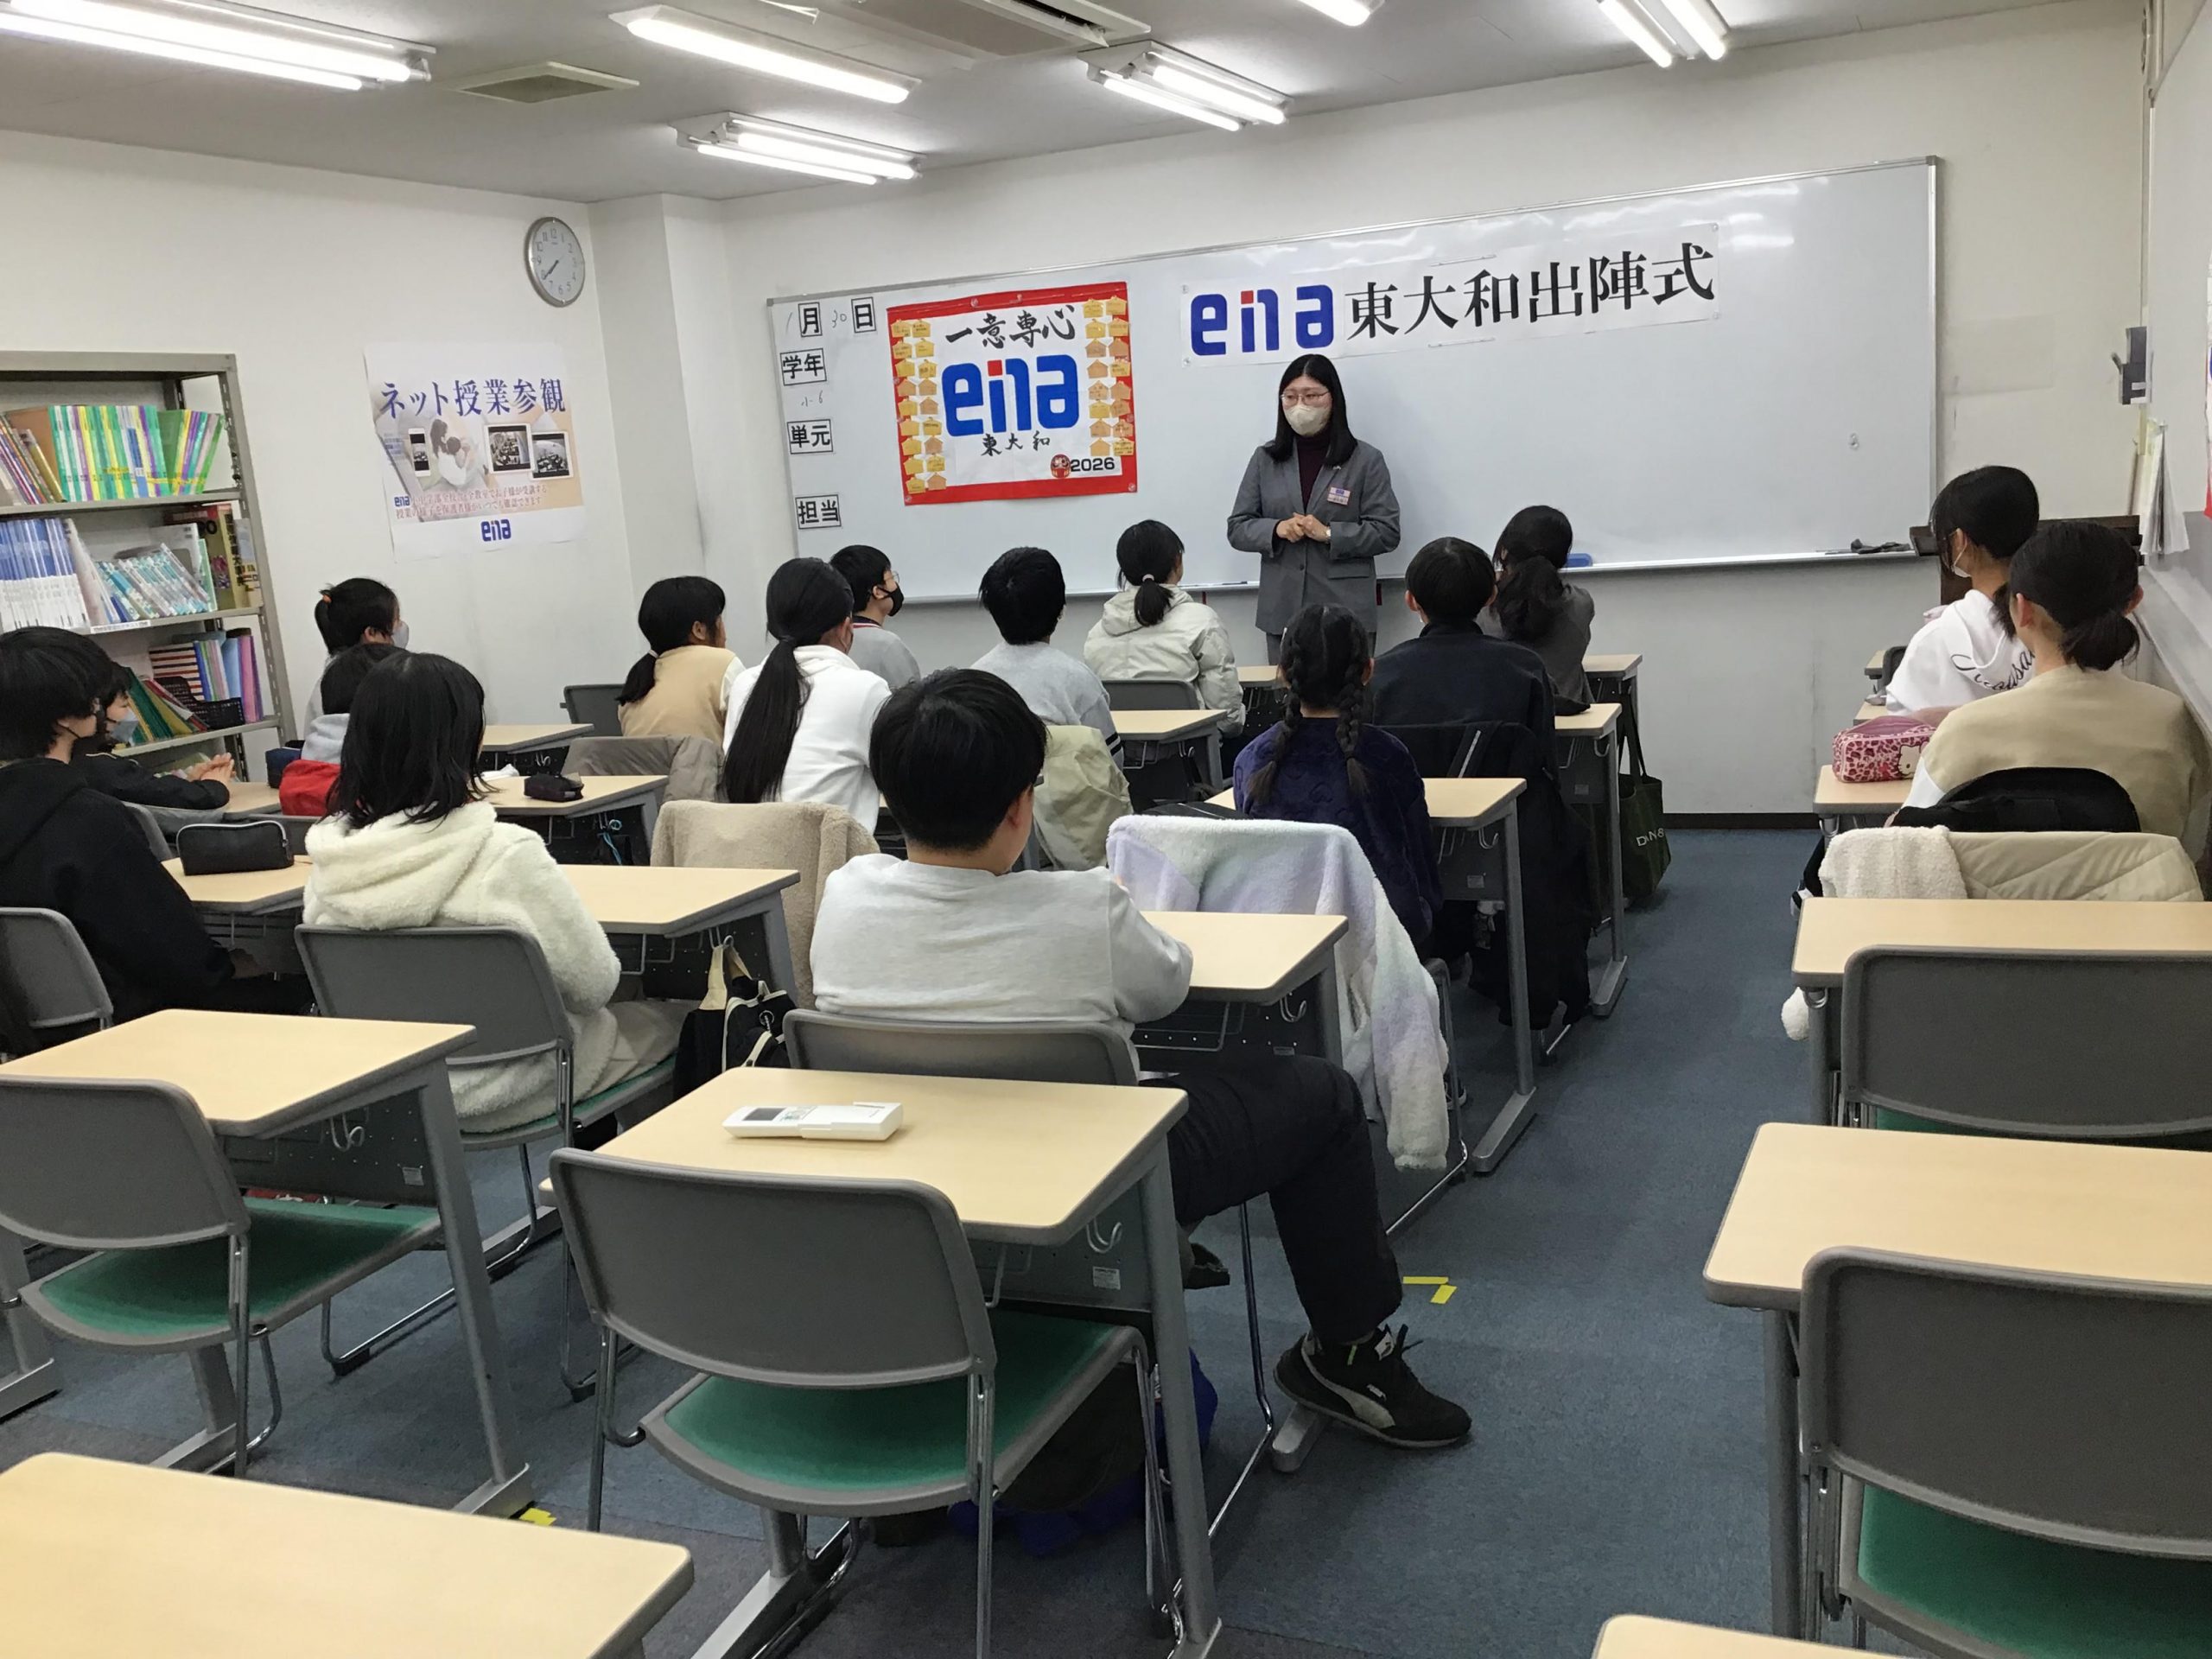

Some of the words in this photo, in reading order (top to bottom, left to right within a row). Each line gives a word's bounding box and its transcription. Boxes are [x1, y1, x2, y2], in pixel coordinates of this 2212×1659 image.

[1191, 284, 1335, 356] ena
[1346, 242, 1715, 340] 東大和出陣式
[803, 308, 820, 334] 月
[855, 304, 874, 328] 日
[945, 305, 1076, 349] 一意専心
[783, 353, 824, 379] 学年
[379, 378, 566, 418] ネット授業参観
[942, 354, 1079, 436] ena
[791, 424, 831, 448] 単元
[981, 431, 1051, 456] 東大和
[1070, 456, 1116, 473] 2026
[394, 496, 410, 506] ena
[798, 499, 841, 524] 担当
[481, 518, 512, 542] ena
